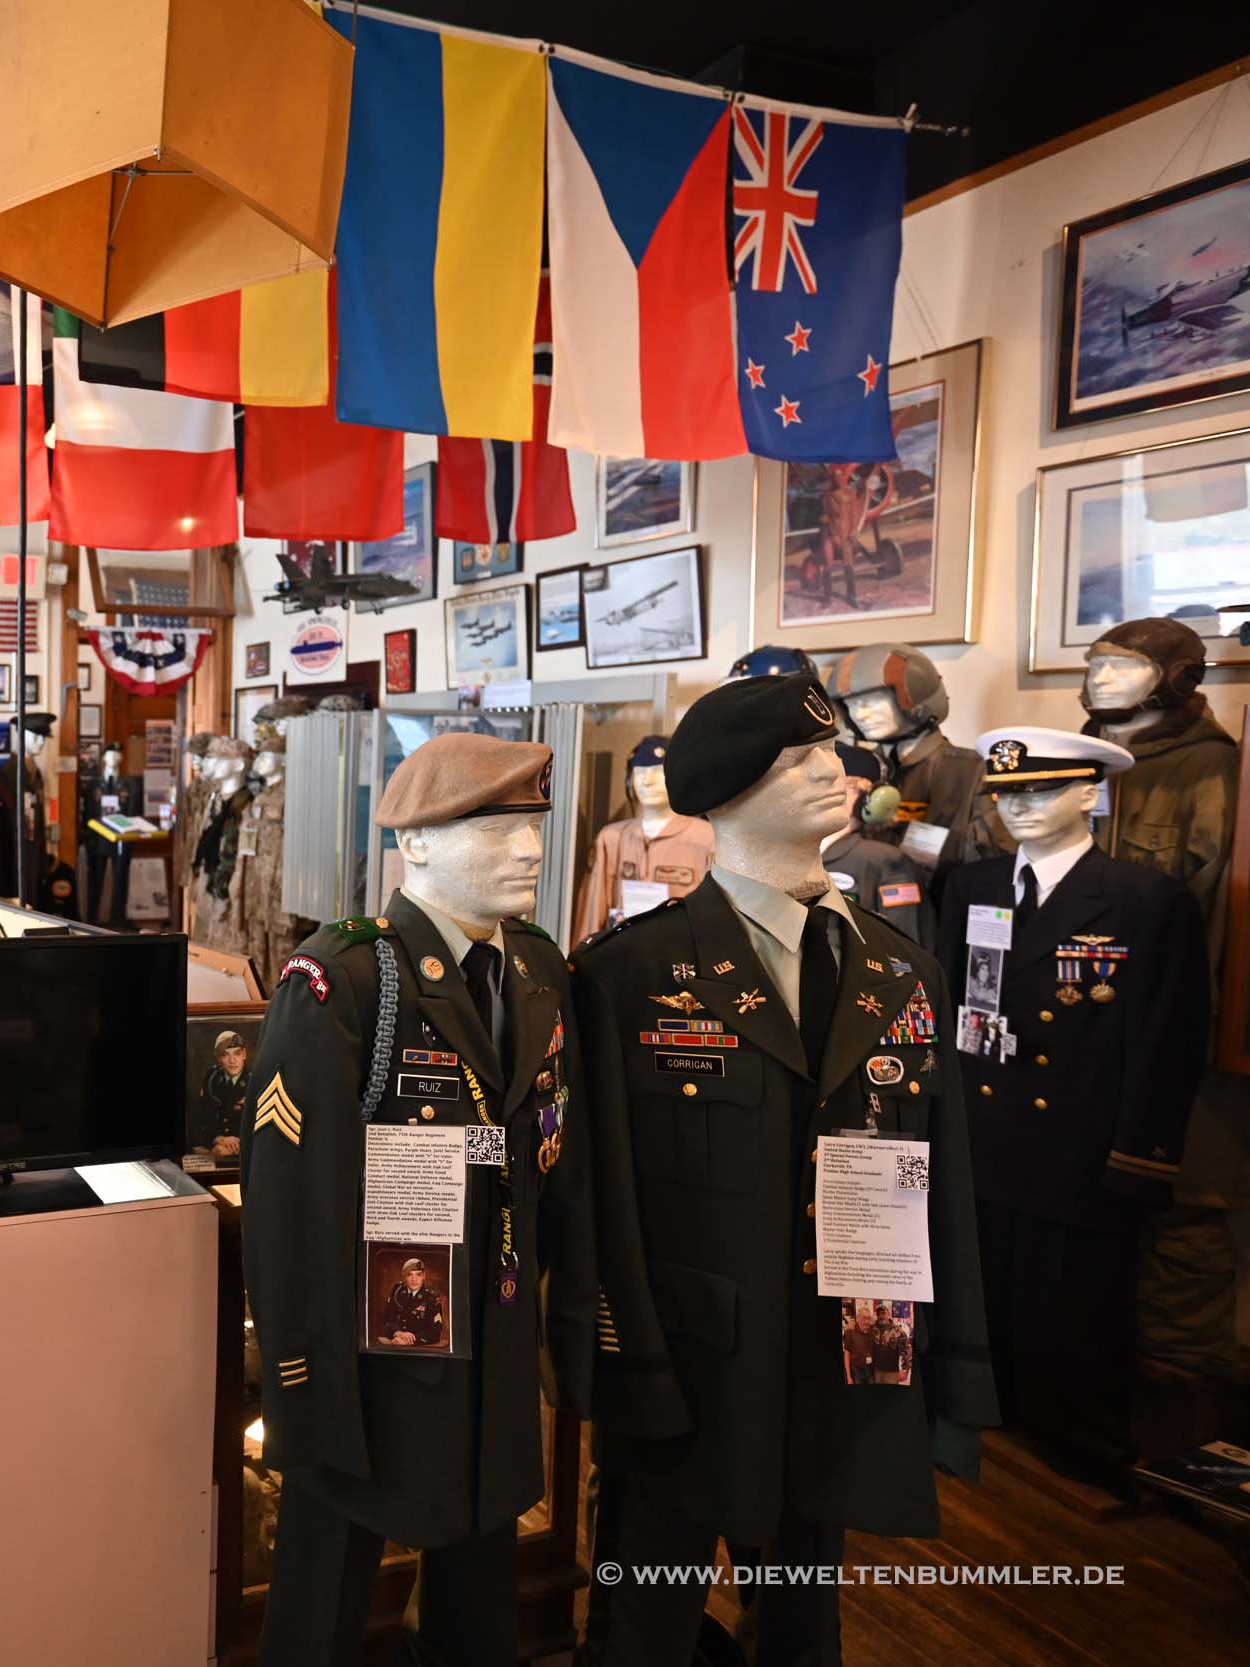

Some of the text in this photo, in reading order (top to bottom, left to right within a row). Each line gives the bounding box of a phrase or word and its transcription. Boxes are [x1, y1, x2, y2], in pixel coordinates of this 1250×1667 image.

[288, 958, 321, 980] RANGER
[667, 1058, 713, 1071] CORRIGAN
[418, 1081, 442, 1093] RUIZ
